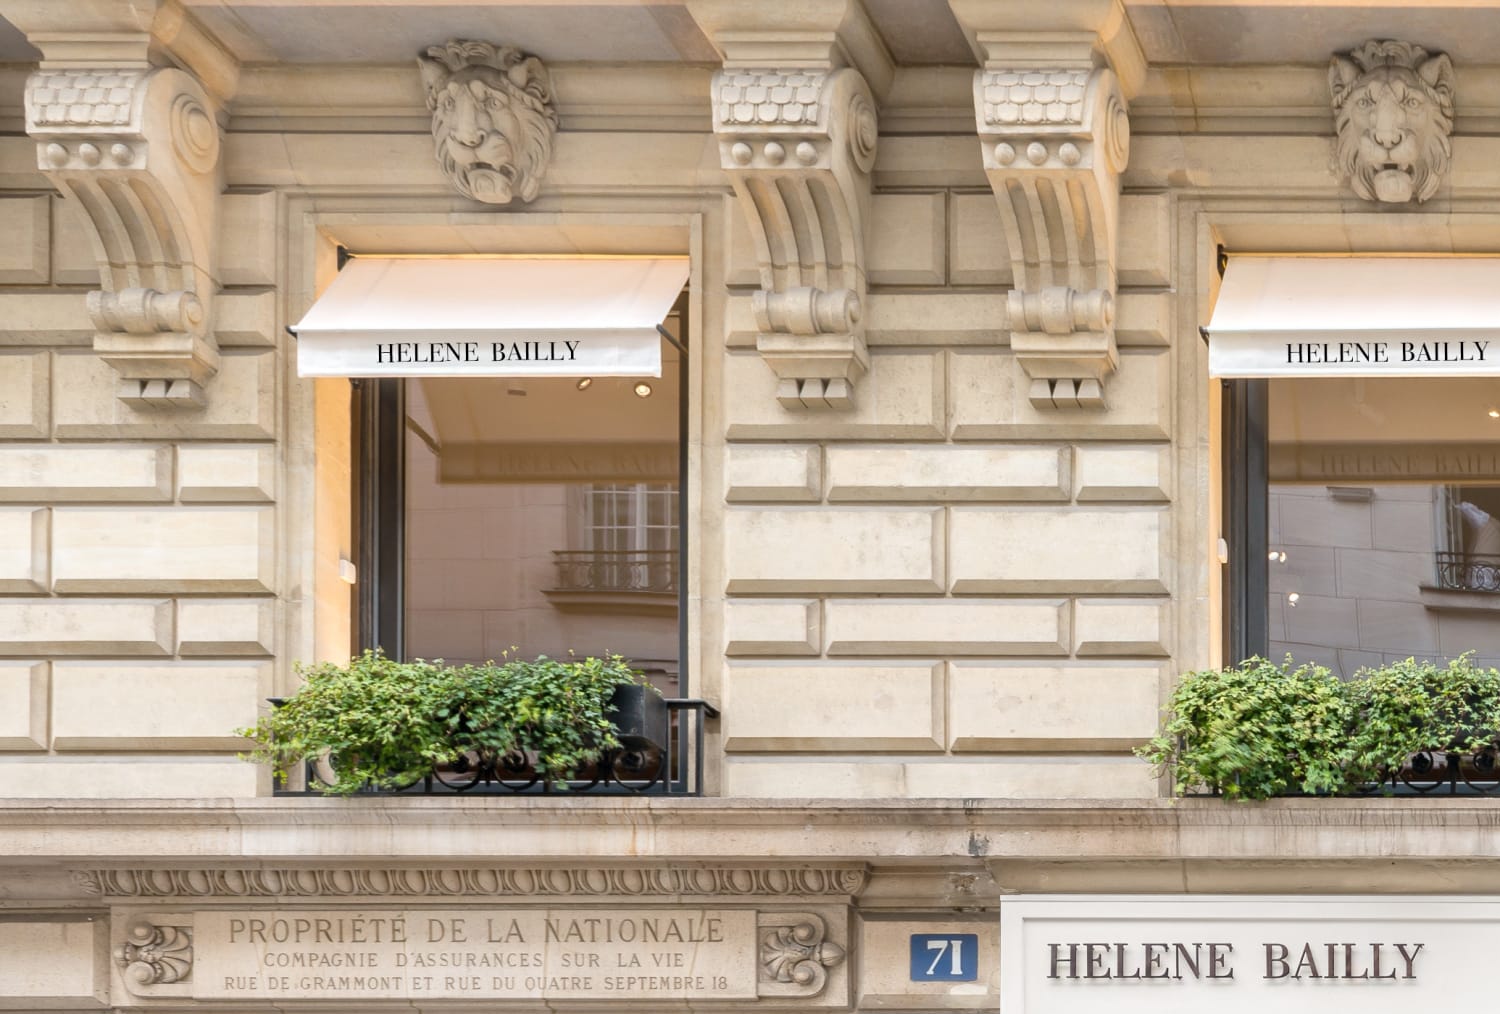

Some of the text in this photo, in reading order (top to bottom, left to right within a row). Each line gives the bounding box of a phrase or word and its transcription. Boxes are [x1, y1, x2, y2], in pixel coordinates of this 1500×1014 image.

[376, 341, 580, 363] HELENE BAILLY
[1285, 341, 1490, 363] HELENE BAILLY
[229, 914, 724, 944] PROPRIÉTÉ DE LA NATIONALE
[264, 952, 684, 968] COMPAGNIE D'ASSURANCES SUR LA VIE
[926, 940, 963, 975] 71
[1046, 942, 1425, 981] HELENE BAILLY
[224, 976, 728, 991] RUE DE GRAMMONT ET RUE DU QUATRE SEPTEMBRE 18
